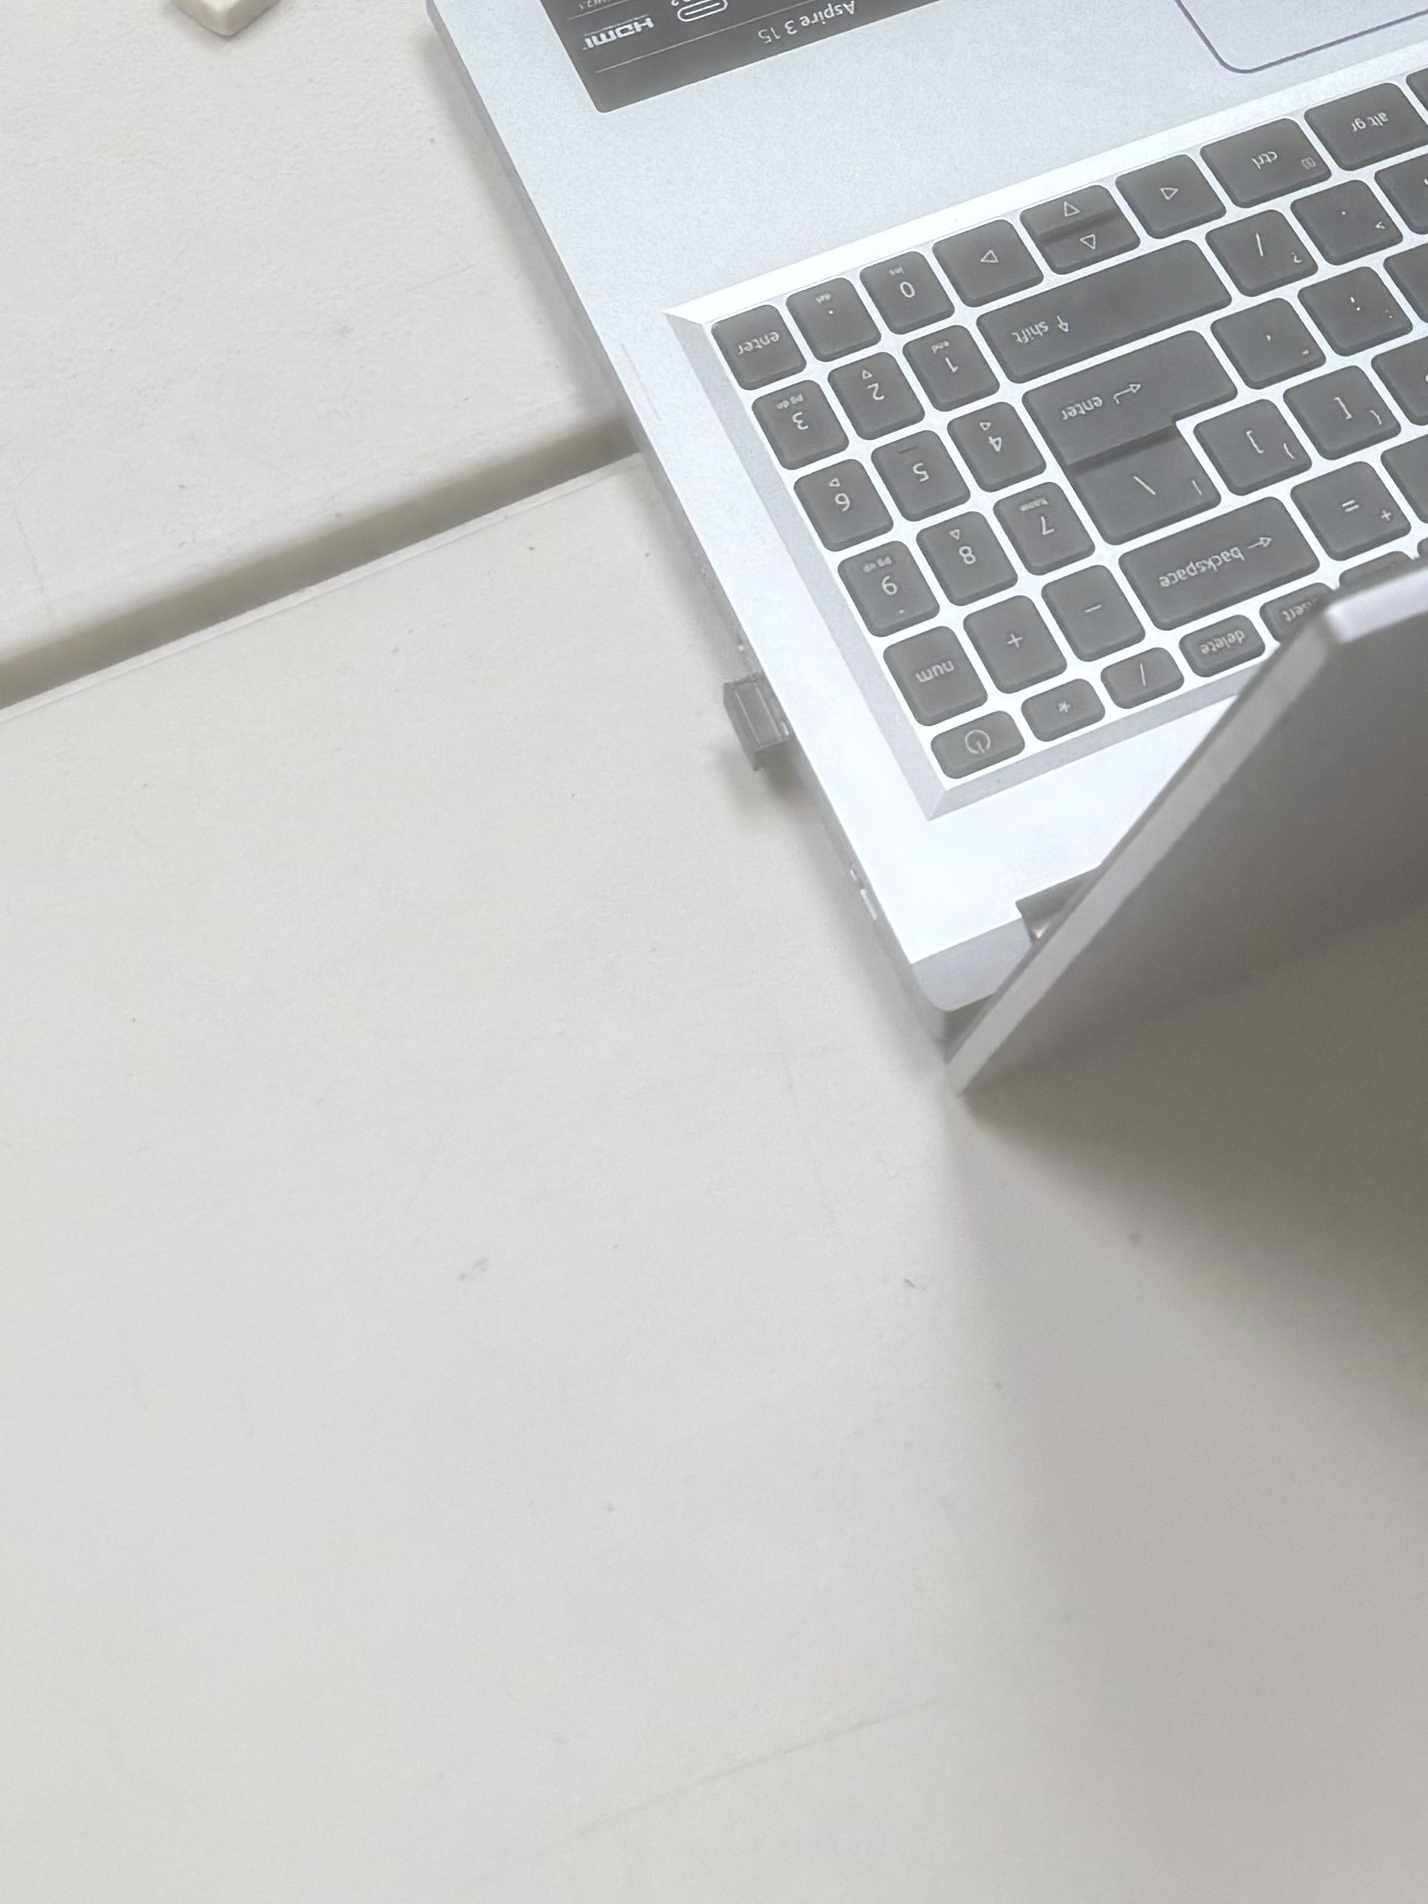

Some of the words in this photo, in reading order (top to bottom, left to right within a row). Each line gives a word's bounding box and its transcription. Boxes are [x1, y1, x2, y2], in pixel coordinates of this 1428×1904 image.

[799, 0, 855, 27] Aspire
[585, 17, 653, 48] HDMI
[758, 27, 780, 43] 15
[785, 21, 797, 34] 3
[1351, 117, 1366, 132] gr
[1367, 112, 1389, 126] alt
[1251, 151, 1278, 170] ctrl
[899, 281, 916, 298] 0
[1011, 321, 1049, 344] shift
[738, 331, 780, 355] enter
[944, 357, 958, 373] 1
[867, 382, 885, 401] 2
[1061, 396, 1103, 420] enter
[792, 411, 809, 431] 3
[988, 436, 1003, 453] 4
[912, 462, 929, 482] 5
[834, 492, 851, 512] 6
[1040, 516, 1055, 536] 7
[958, 545, 976, 565] 8
[1158, 546, 1245, 588] backspace
[881, 575, 898, 596] 9
[1200, 627, 1246, 657] delete
[915, 660, 955, 683] num
